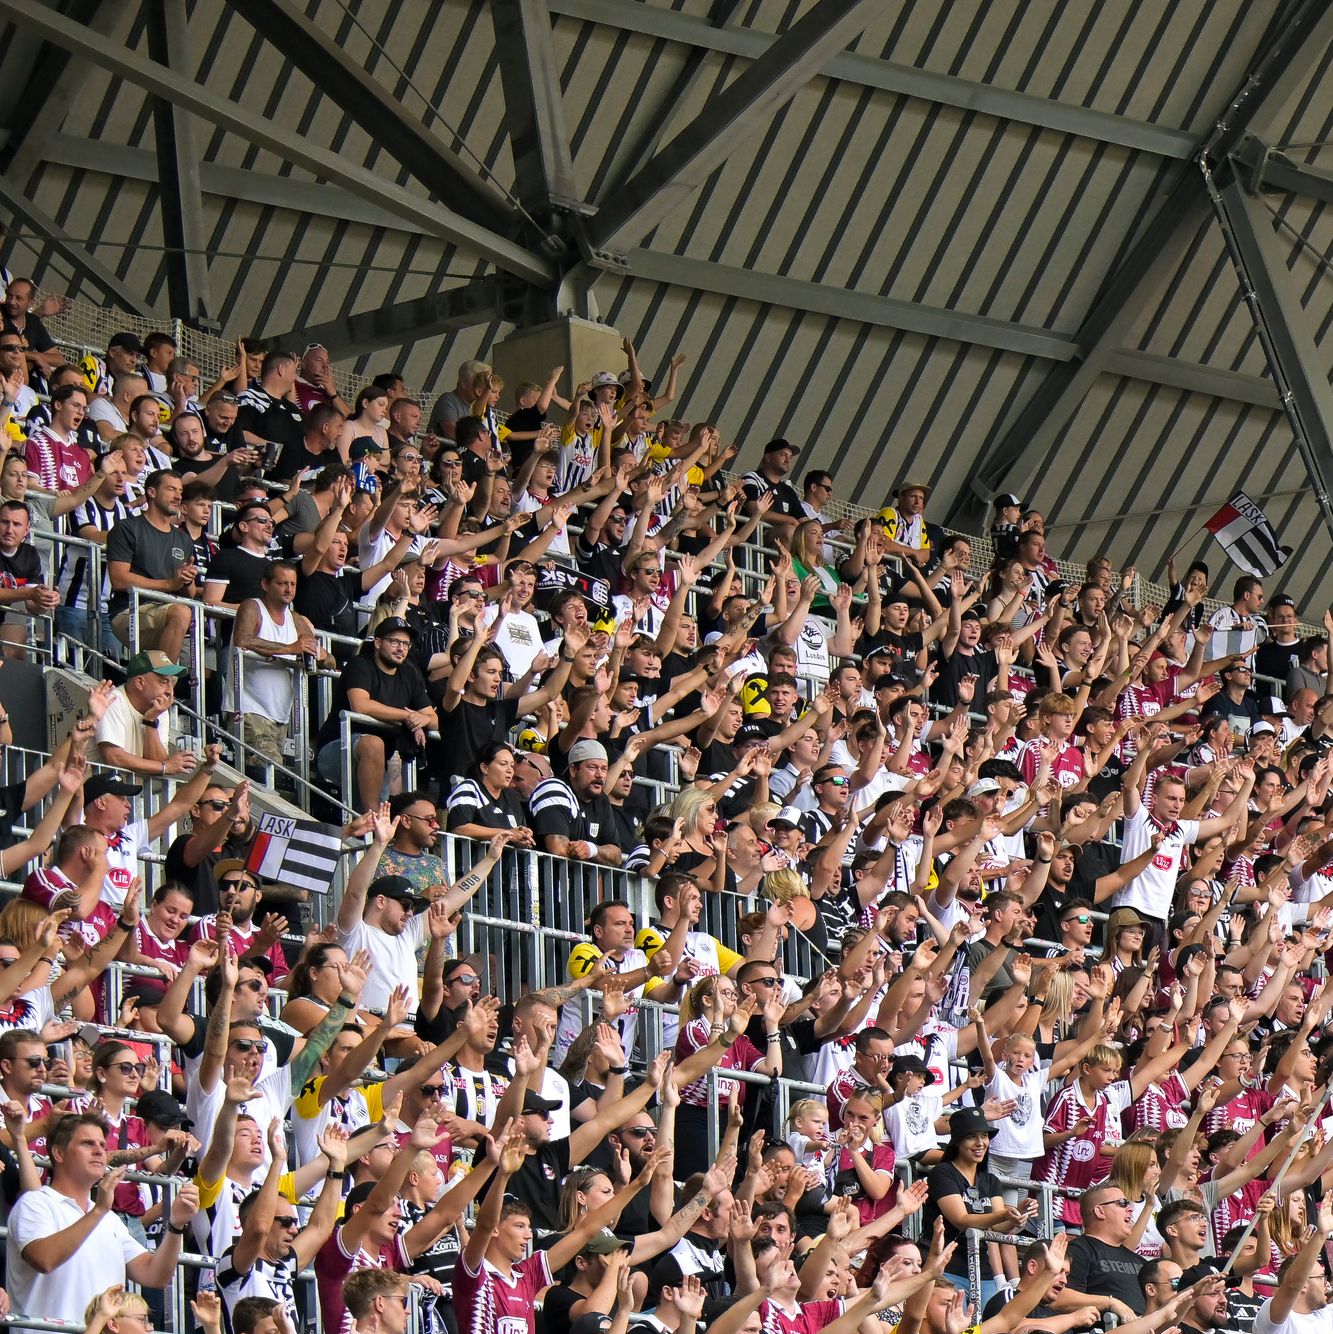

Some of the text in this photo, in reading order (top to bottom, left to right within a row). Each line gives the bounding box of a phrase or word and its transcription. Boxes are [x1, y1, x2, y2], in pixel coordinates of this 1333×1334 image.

[1233, 494, 1264, 526] LASK
[258, 814, 294, 839] LASK
[458, 873, 481, 892] 1908
